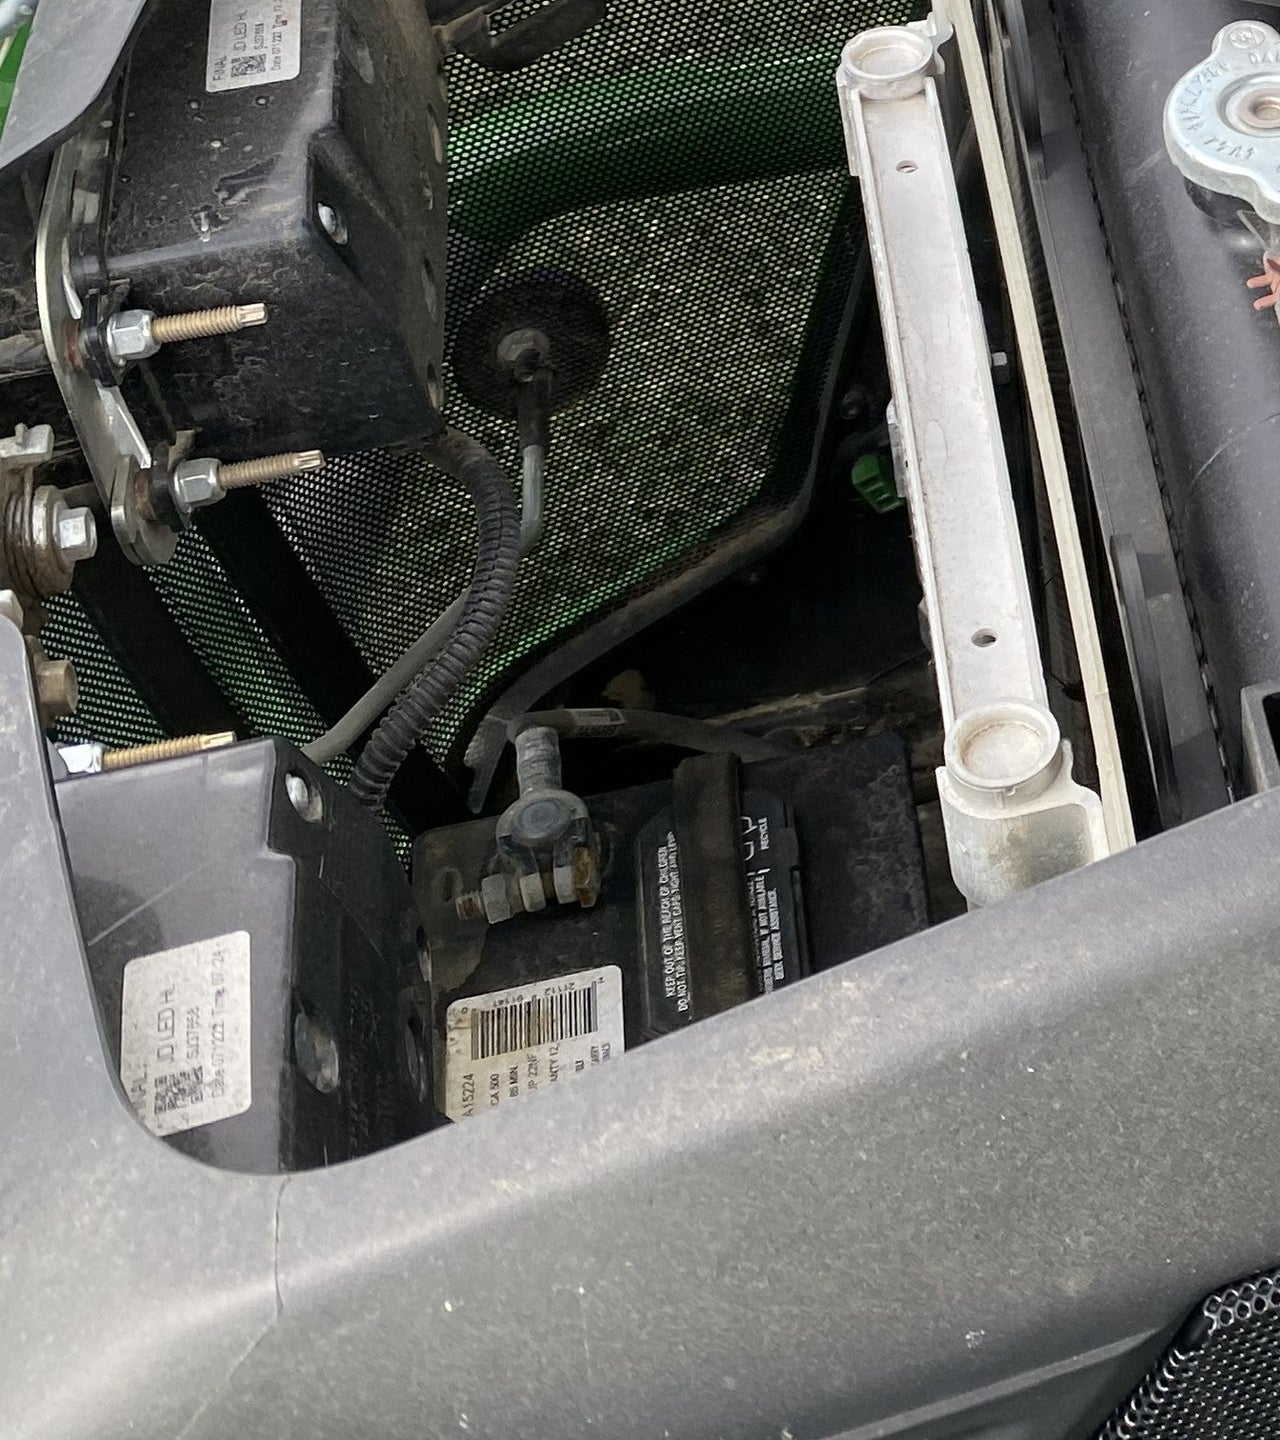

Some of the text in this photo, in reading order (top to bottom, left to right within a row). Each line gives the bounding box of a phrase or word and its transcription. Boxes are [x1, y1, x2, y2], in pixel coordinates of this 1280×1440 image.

[674, 940, 685, 962] KEEP
[664, 958, 675, 975] OUT
[665, 977, 676, 999] KEEP
[676, 981, 687, 998] NOT
[677, 999, 689, 1012] DO
[157, 1008, 175, 1039] LED
